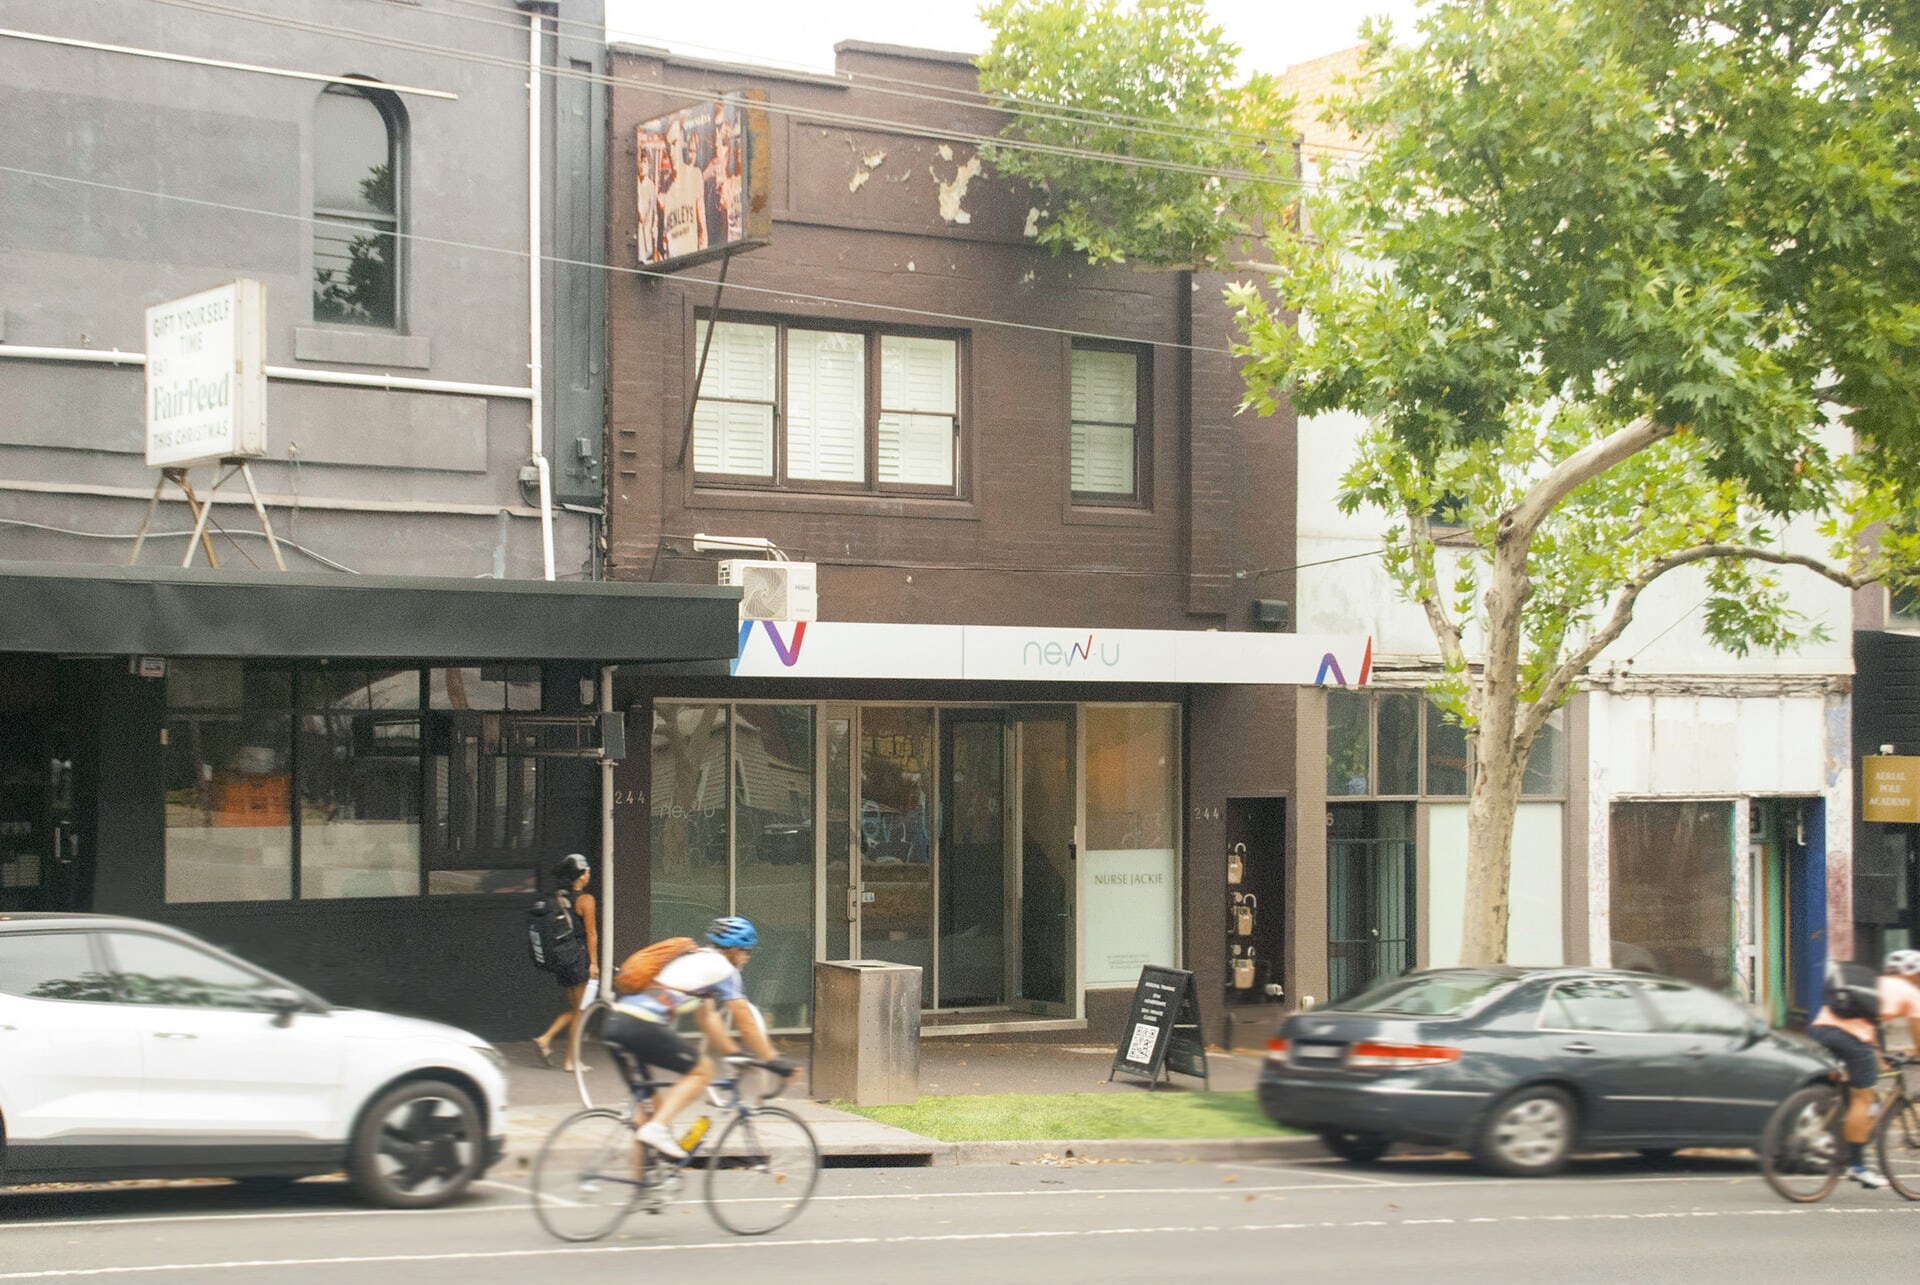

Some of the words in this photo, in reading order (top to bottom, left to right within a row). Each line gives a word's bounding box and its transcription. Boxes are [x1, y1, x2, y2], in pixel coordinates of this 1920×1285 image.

[153, 313, 175, 338] GIFT
[177, 299, 230, 333] YOURSELF
[180, 331, 203, 355] TIME
[153, 358, 168, 376] EAT
[154, 372, 230, 422] FairFeed
[153, 431, 172, 450] THIS
[175, 419, 229, 446] CHRISTMAS
[615, 791, 645, 805] 244
[1194, 807, 1220, 820] 244
[1095, 873, 1128, 885] NURSE
[1130, 873, 1163, 885] JACKIE
